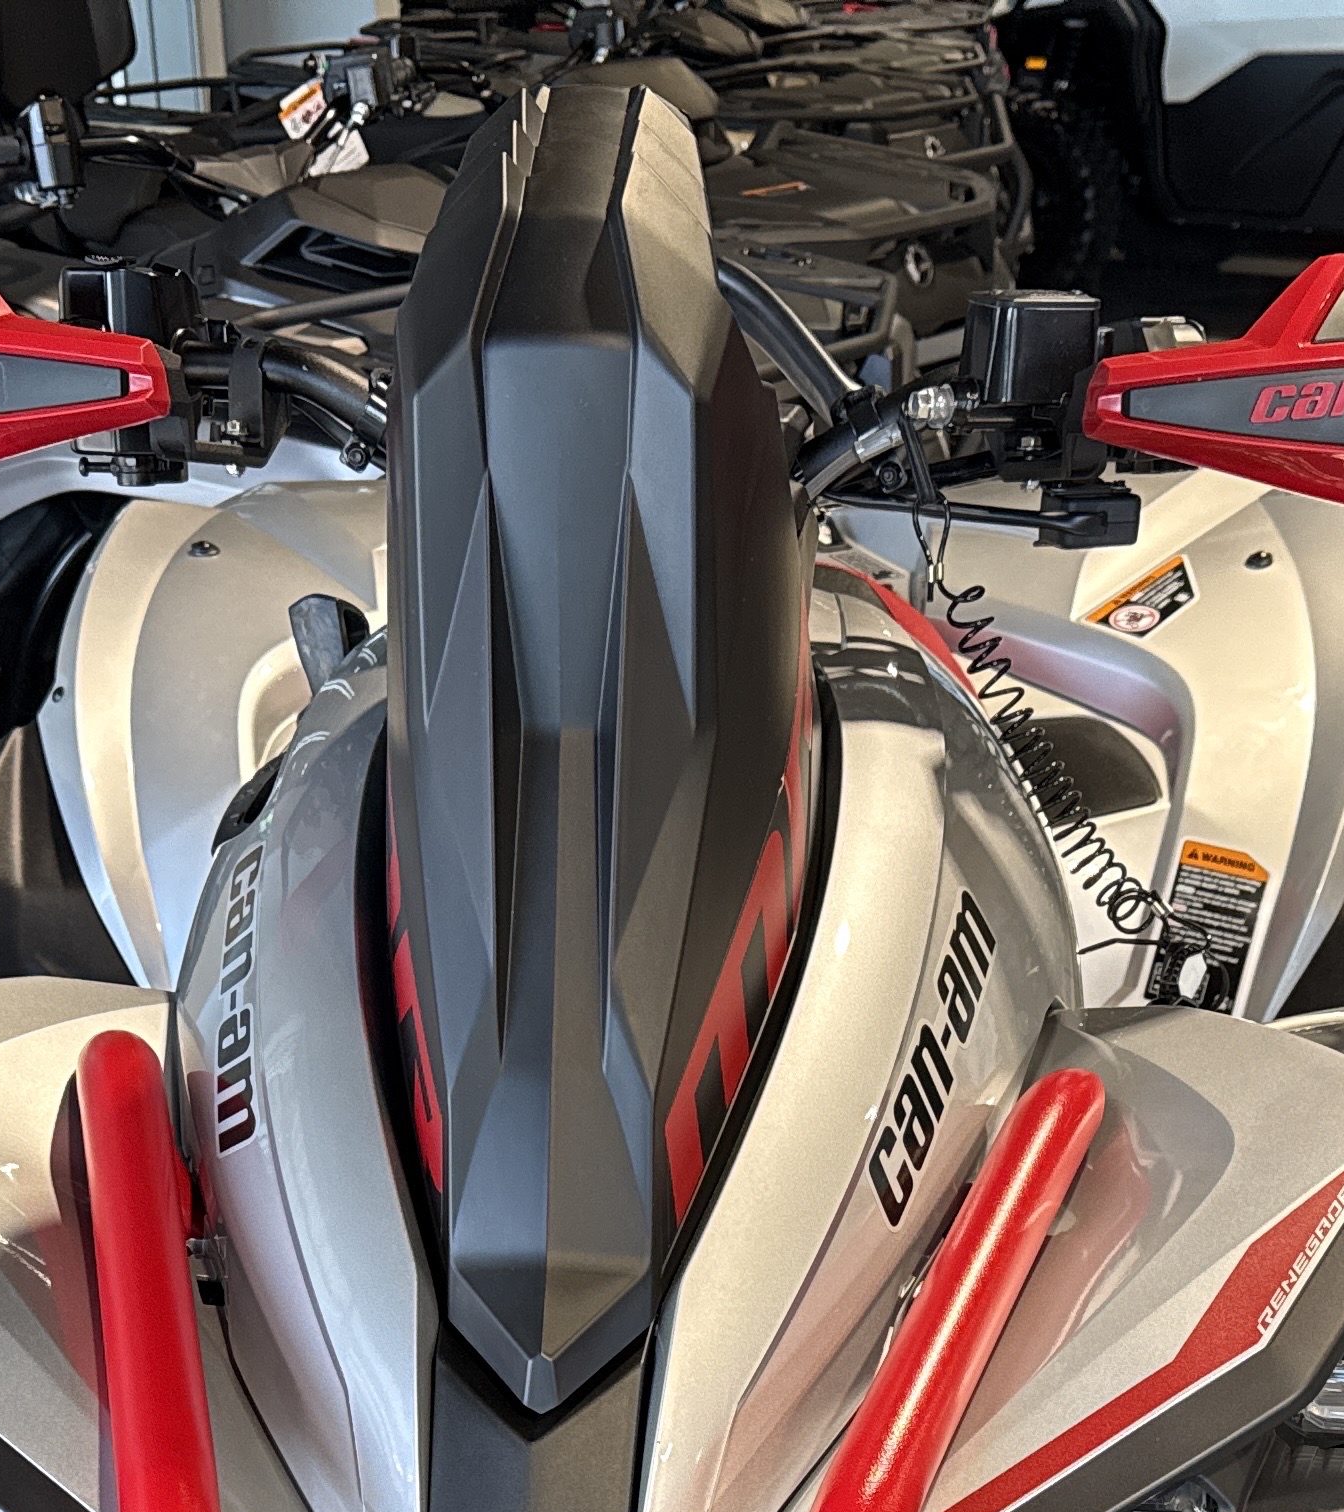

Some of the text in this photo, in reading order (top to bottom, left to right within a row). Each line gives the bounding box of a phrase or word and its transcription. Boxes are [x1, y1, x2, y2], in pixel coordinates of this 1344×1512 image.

[216, 844, 264, 1155] can-am
[1202, 851, 1256, 872] WARNING
[868, 889, 996, 1228] can-am
